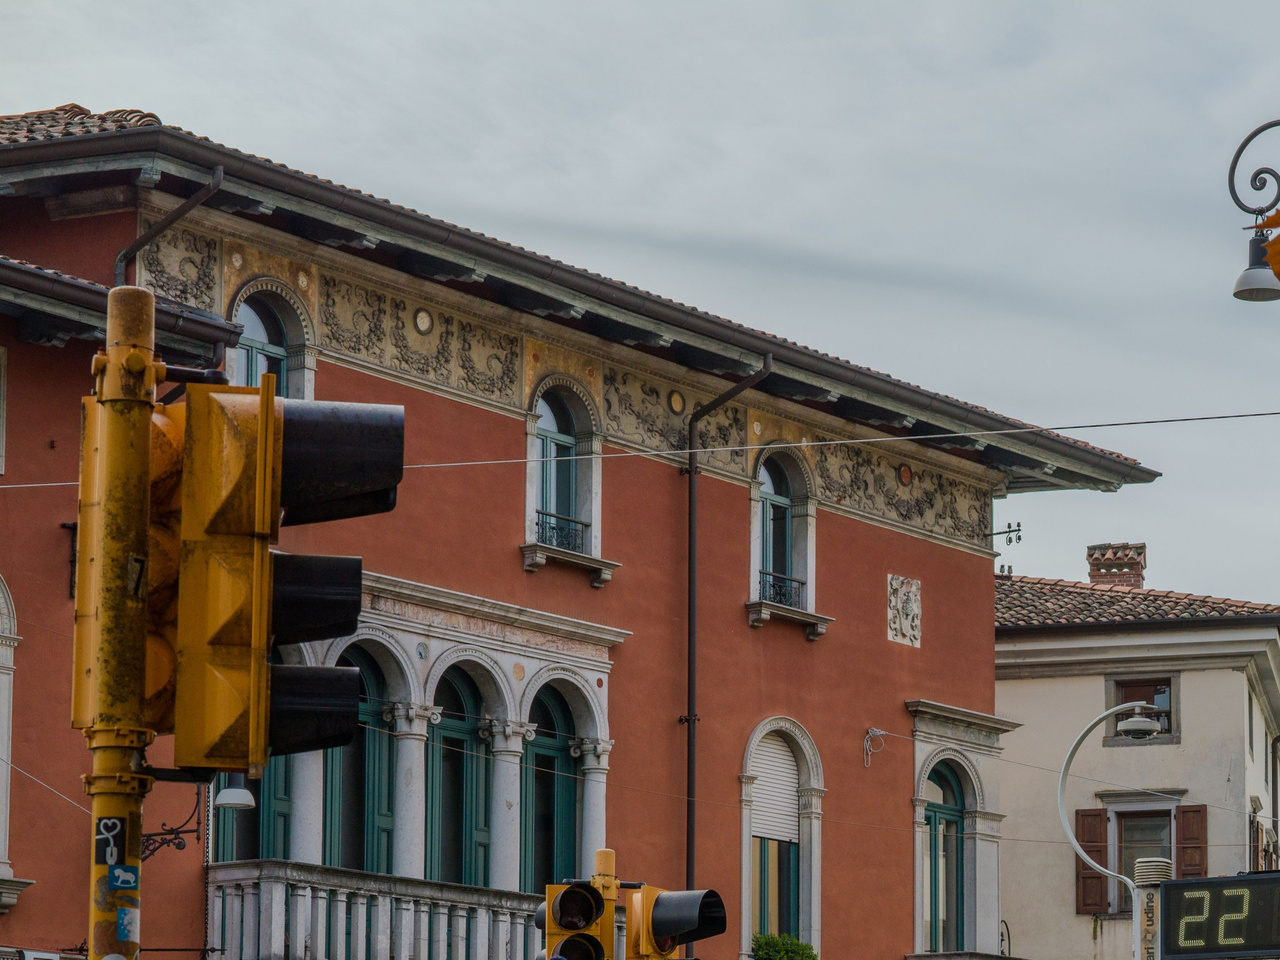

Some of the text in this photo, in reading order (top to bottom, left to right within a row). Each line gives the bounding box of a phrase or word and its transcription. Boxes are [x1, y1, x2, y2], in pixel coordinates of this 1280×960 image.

[133, 557, 145, 596] 7
[1144, 892, 1155, 927] udine
[1178, 888, 1250, 947] 22
